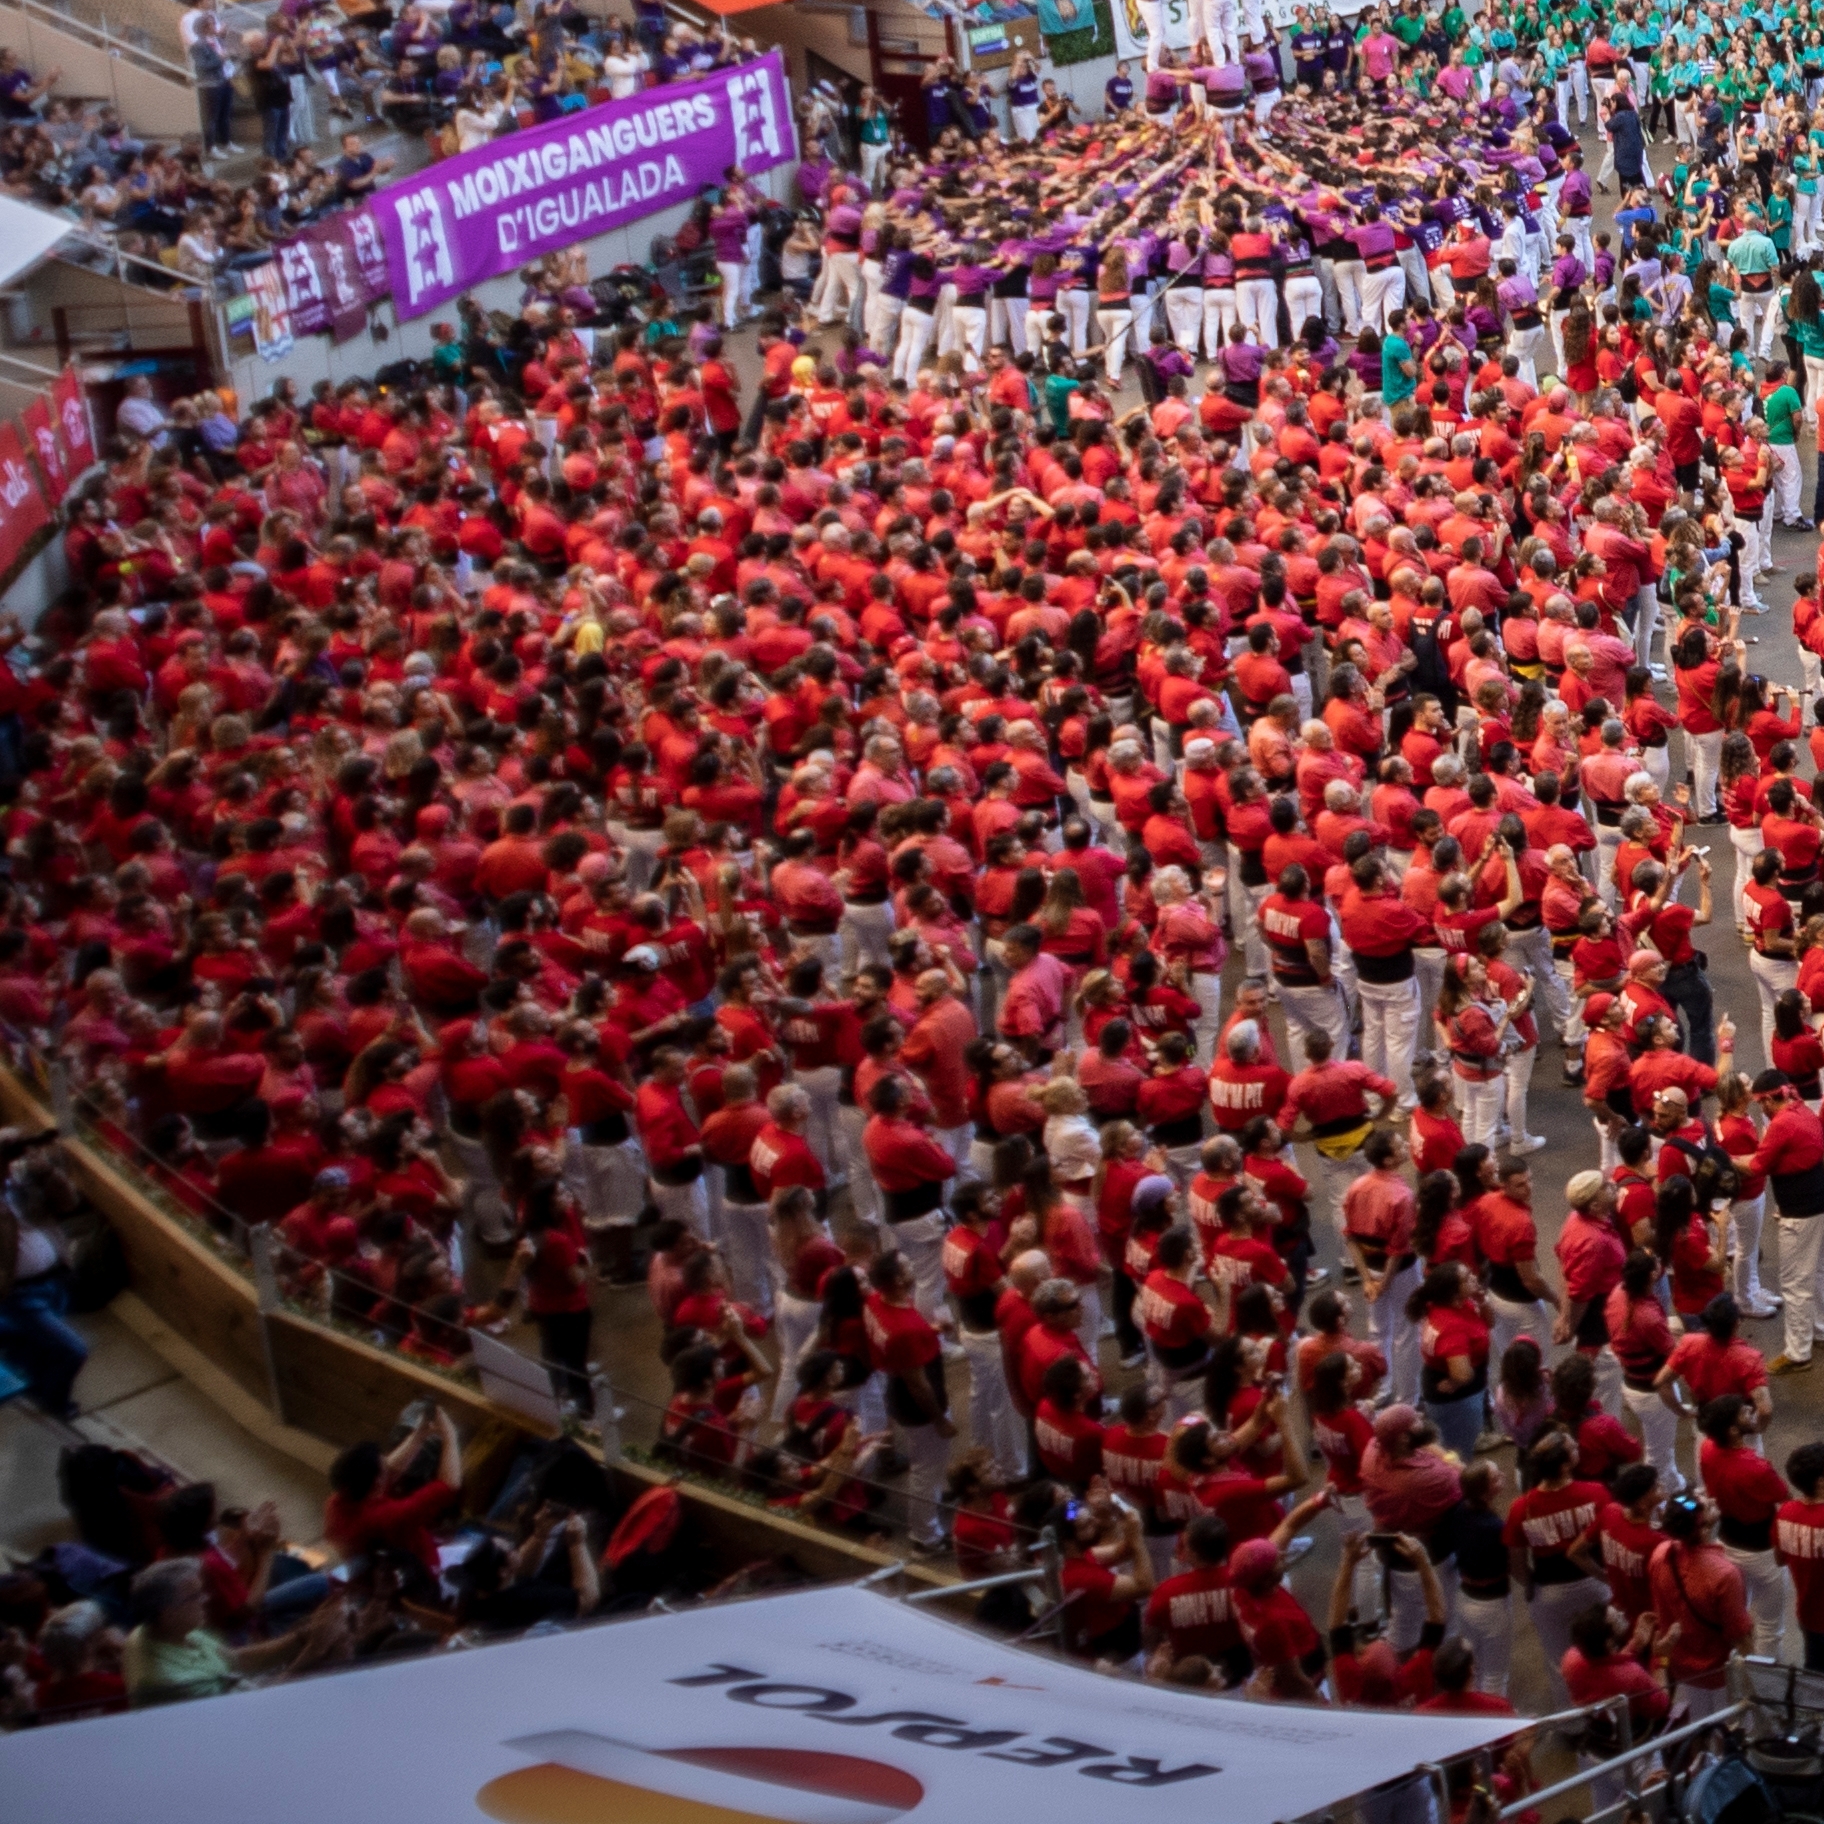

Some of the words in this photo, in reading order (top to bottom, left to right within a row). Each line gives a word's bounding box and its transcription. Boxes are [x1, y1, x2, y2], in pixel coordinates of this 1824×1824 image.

[447, 92, 716, 220] MOIXIGANGUERS
[497, 155, 684, 253] D'IGUALADA
[667, 1662, 1223, 1788] REPSOL
